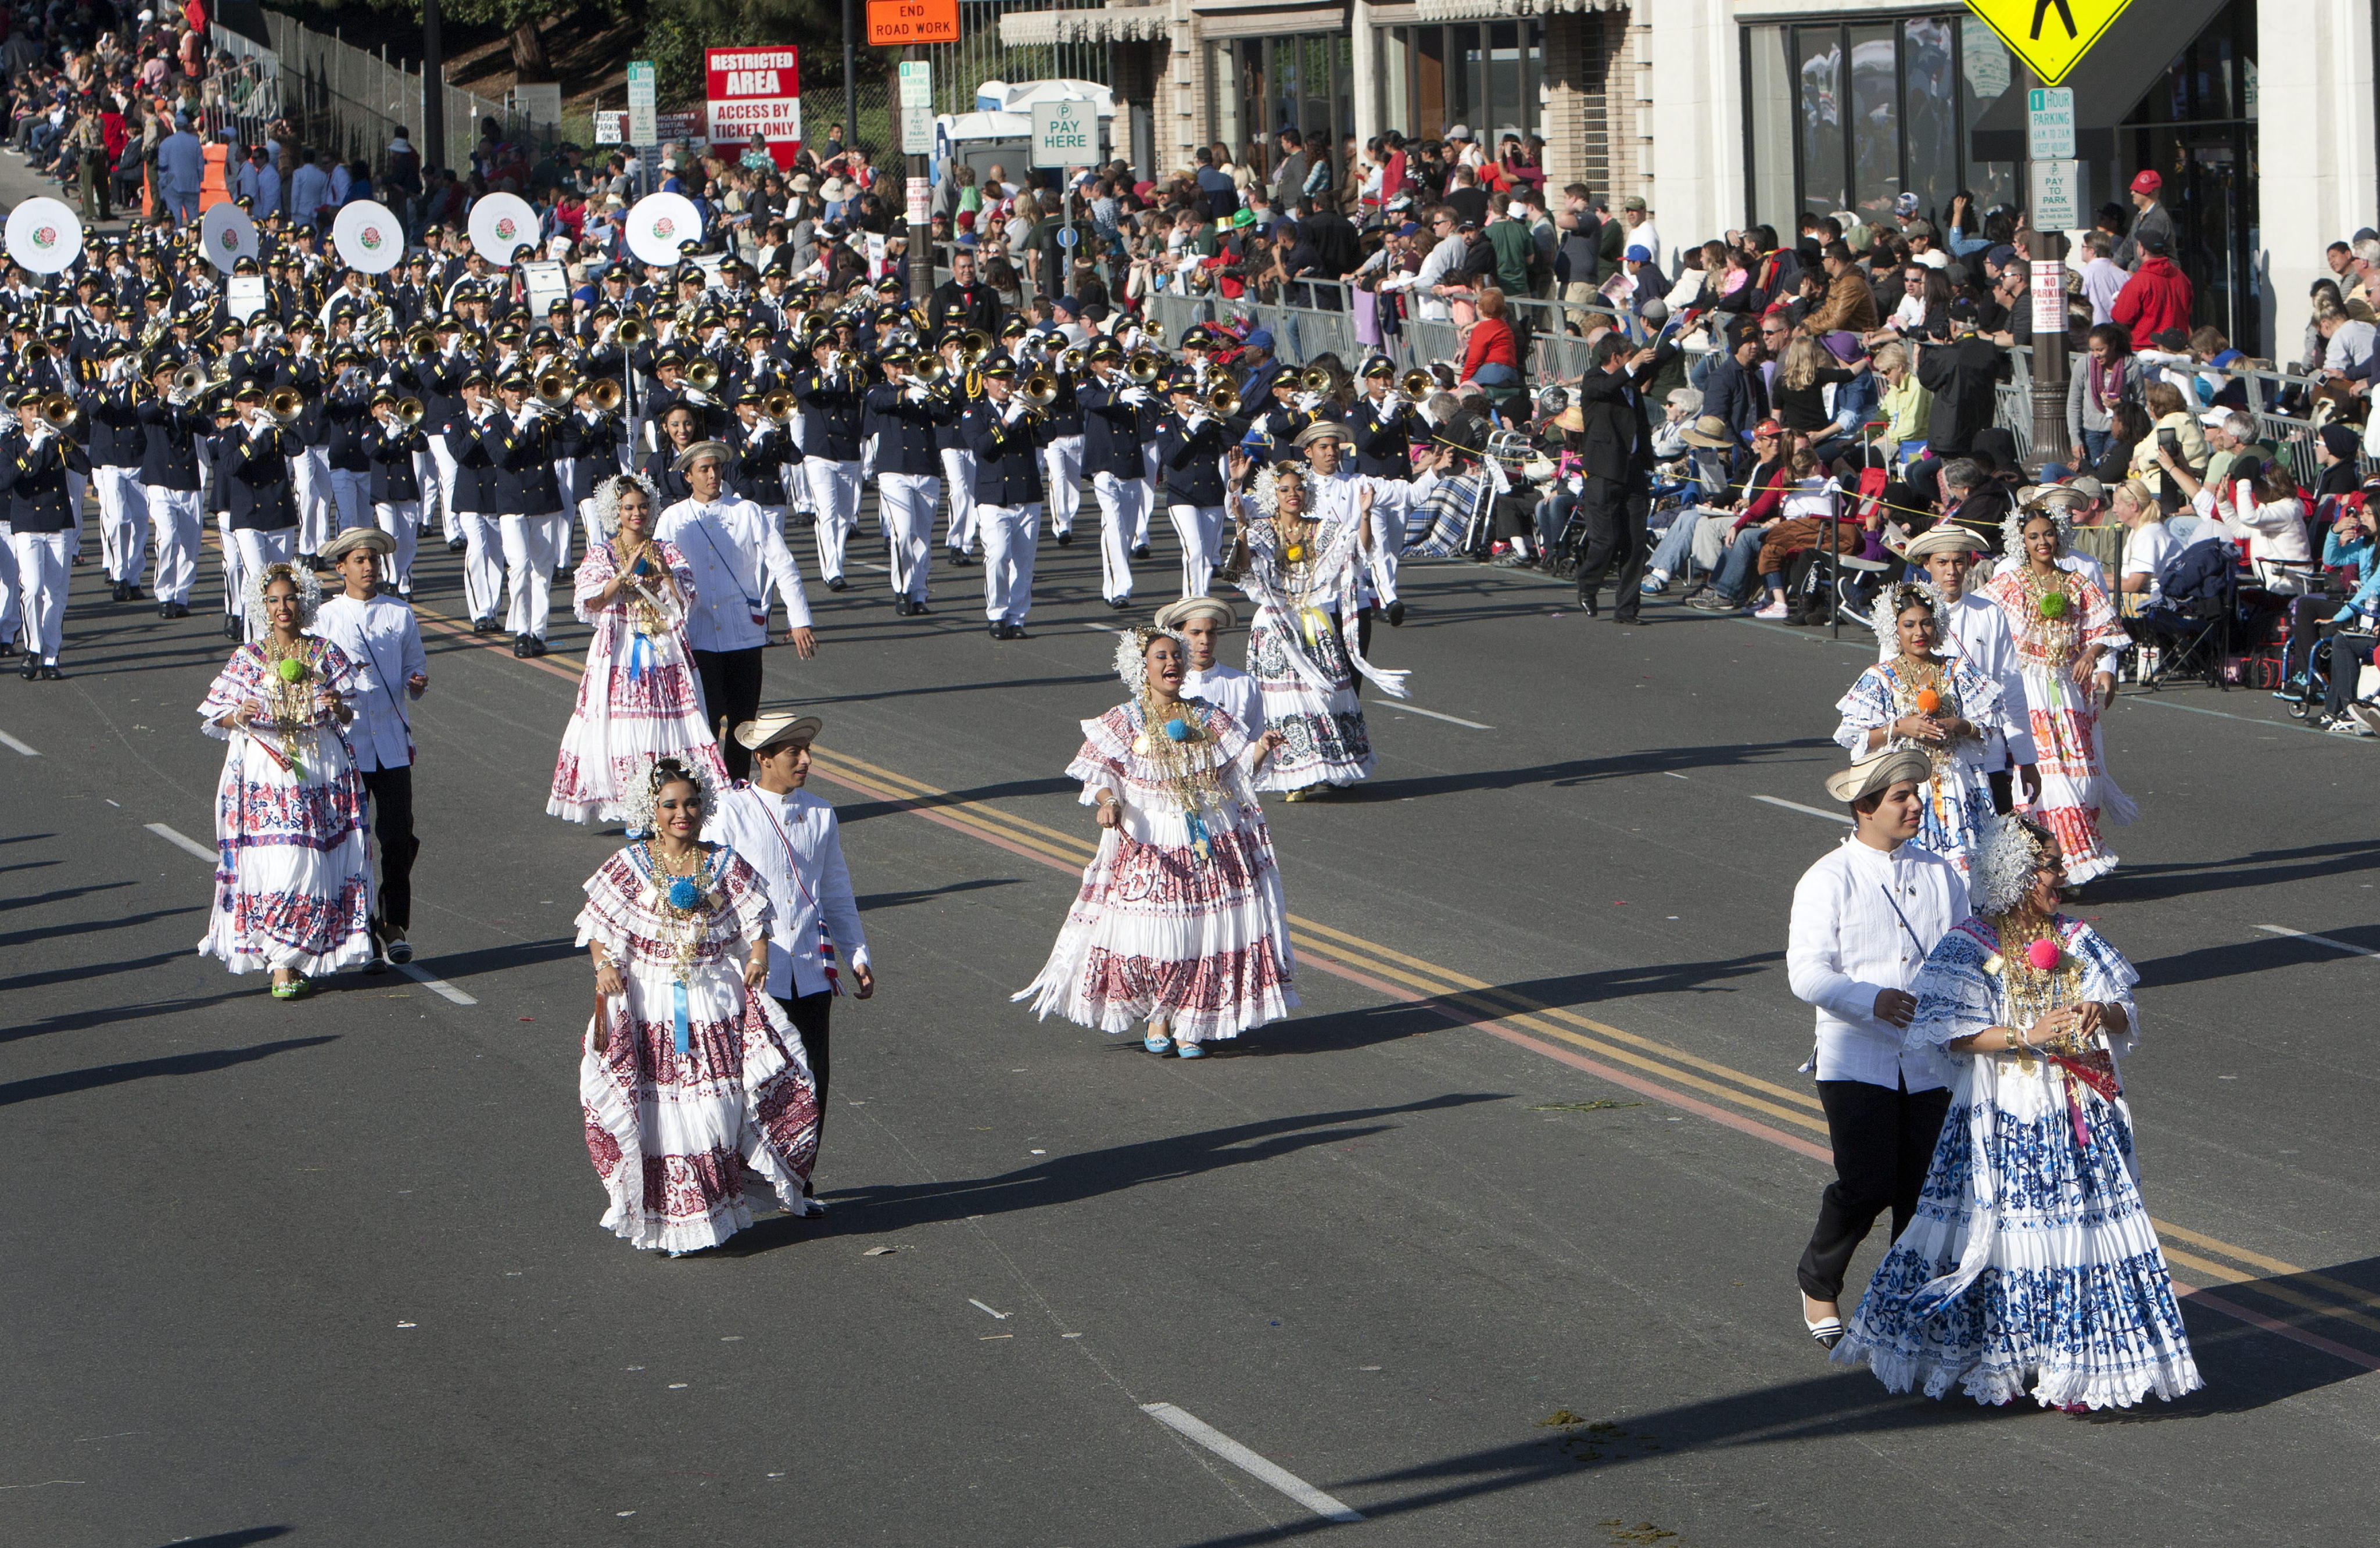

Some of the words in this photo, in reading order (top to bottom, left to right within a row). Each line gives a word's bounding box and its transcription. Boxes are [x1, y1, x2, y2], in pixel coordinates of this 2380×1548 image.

[900, 6, 924, 17] END
[876, 24, 909, 36] ROAD
[916, 21, 951, 34] WORK
[711, 52, 794, 71] RESTRICTED
[726, 70, 781, 95] AREA
[2034, 94, 2039, 109] 1
[2046, 92, 2070, 107] HOUR
[657, 113, 689, 121] HOLDER
[718, 105, 769, 120] ACCESS
[773, 103, 790, 117] BY
[2034, 112, 2070, 126] PARKING
[674, 127, 695, 135] ONLY
[714, 123, 759, 138] TICKET
[764, 121, 794, 136] ONLY
[1050, 120, 1080, 133] PAY
[602, 132, 621, 141] ONLY
[1044, 134, 1087, 148] HERE
[2044, 277, 2056, 286] NO
[2032, 288, 2066, 298] PARKING
